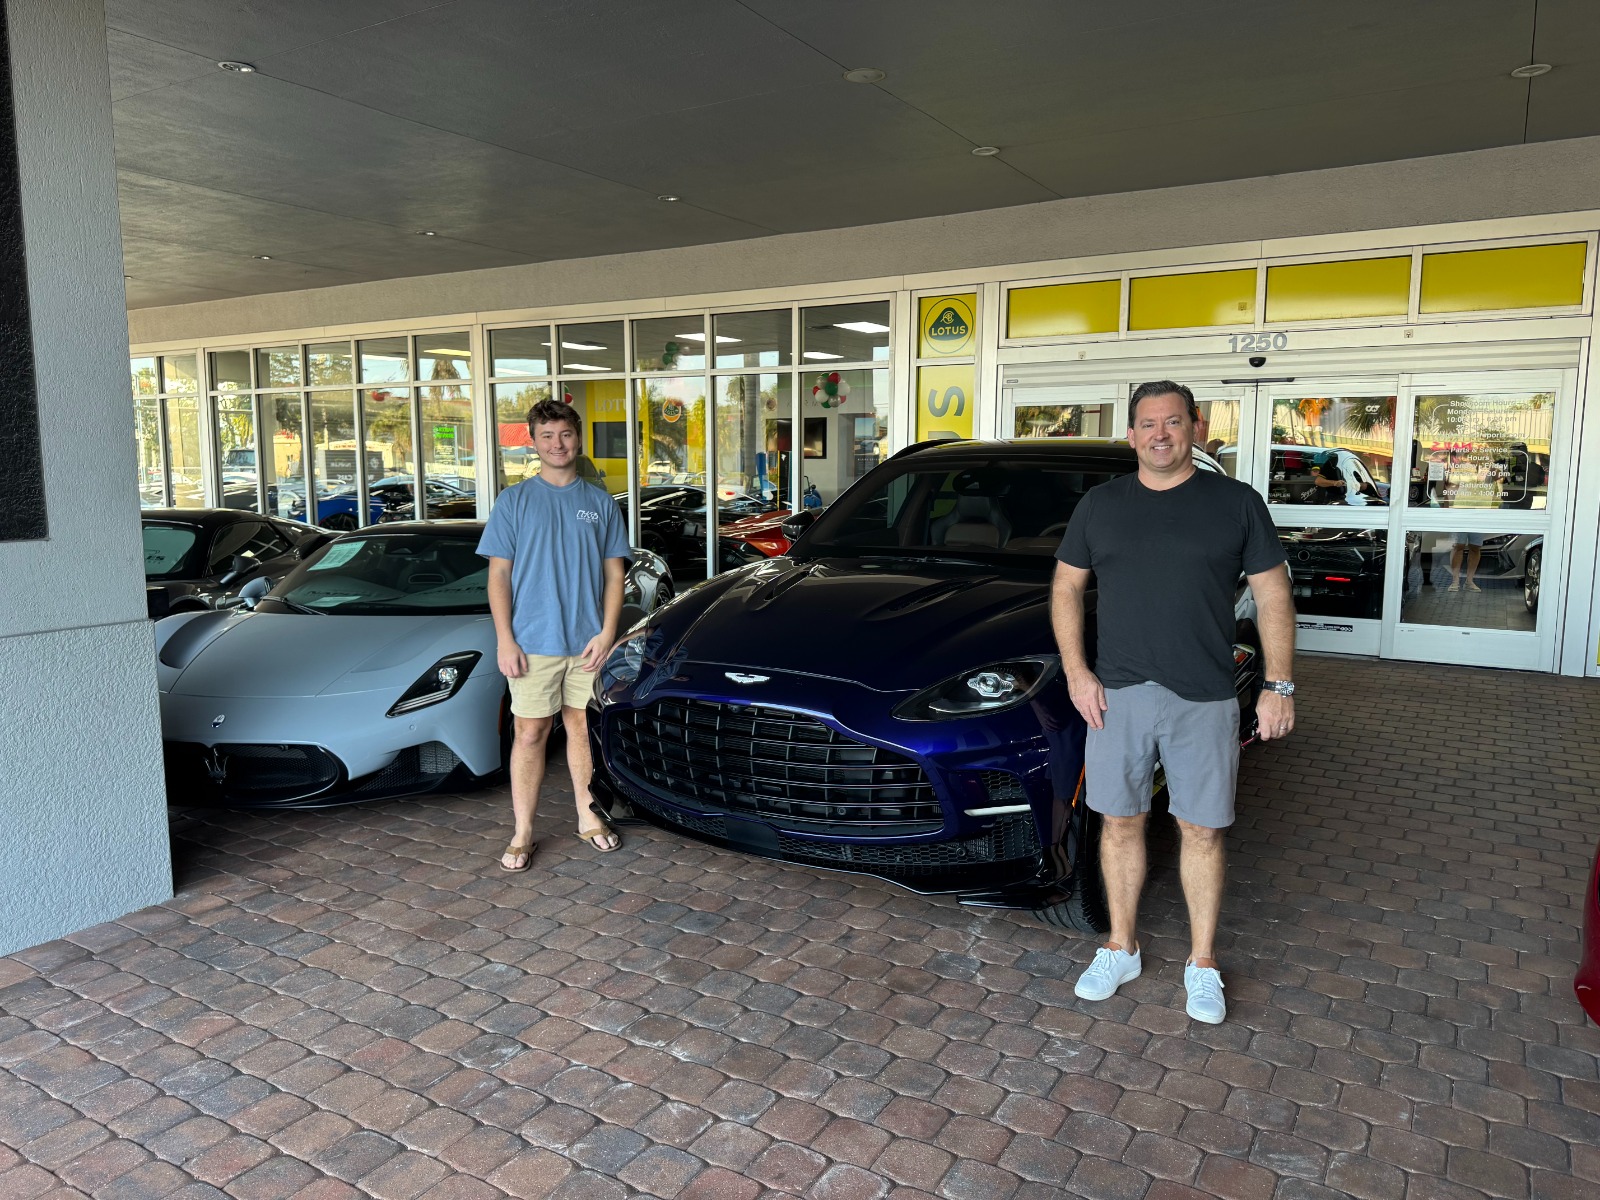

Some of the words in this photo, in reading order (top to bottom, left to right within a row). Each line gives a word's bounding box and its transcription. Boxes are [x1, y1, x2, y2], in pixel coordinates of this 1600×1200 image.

[931, 325, 966, 336] LOTUS
[1228, 332, 1288, 353] 1250
[1492, 399, 1516, 407] Hours
[1484, 462, 1508, 470] Friday
